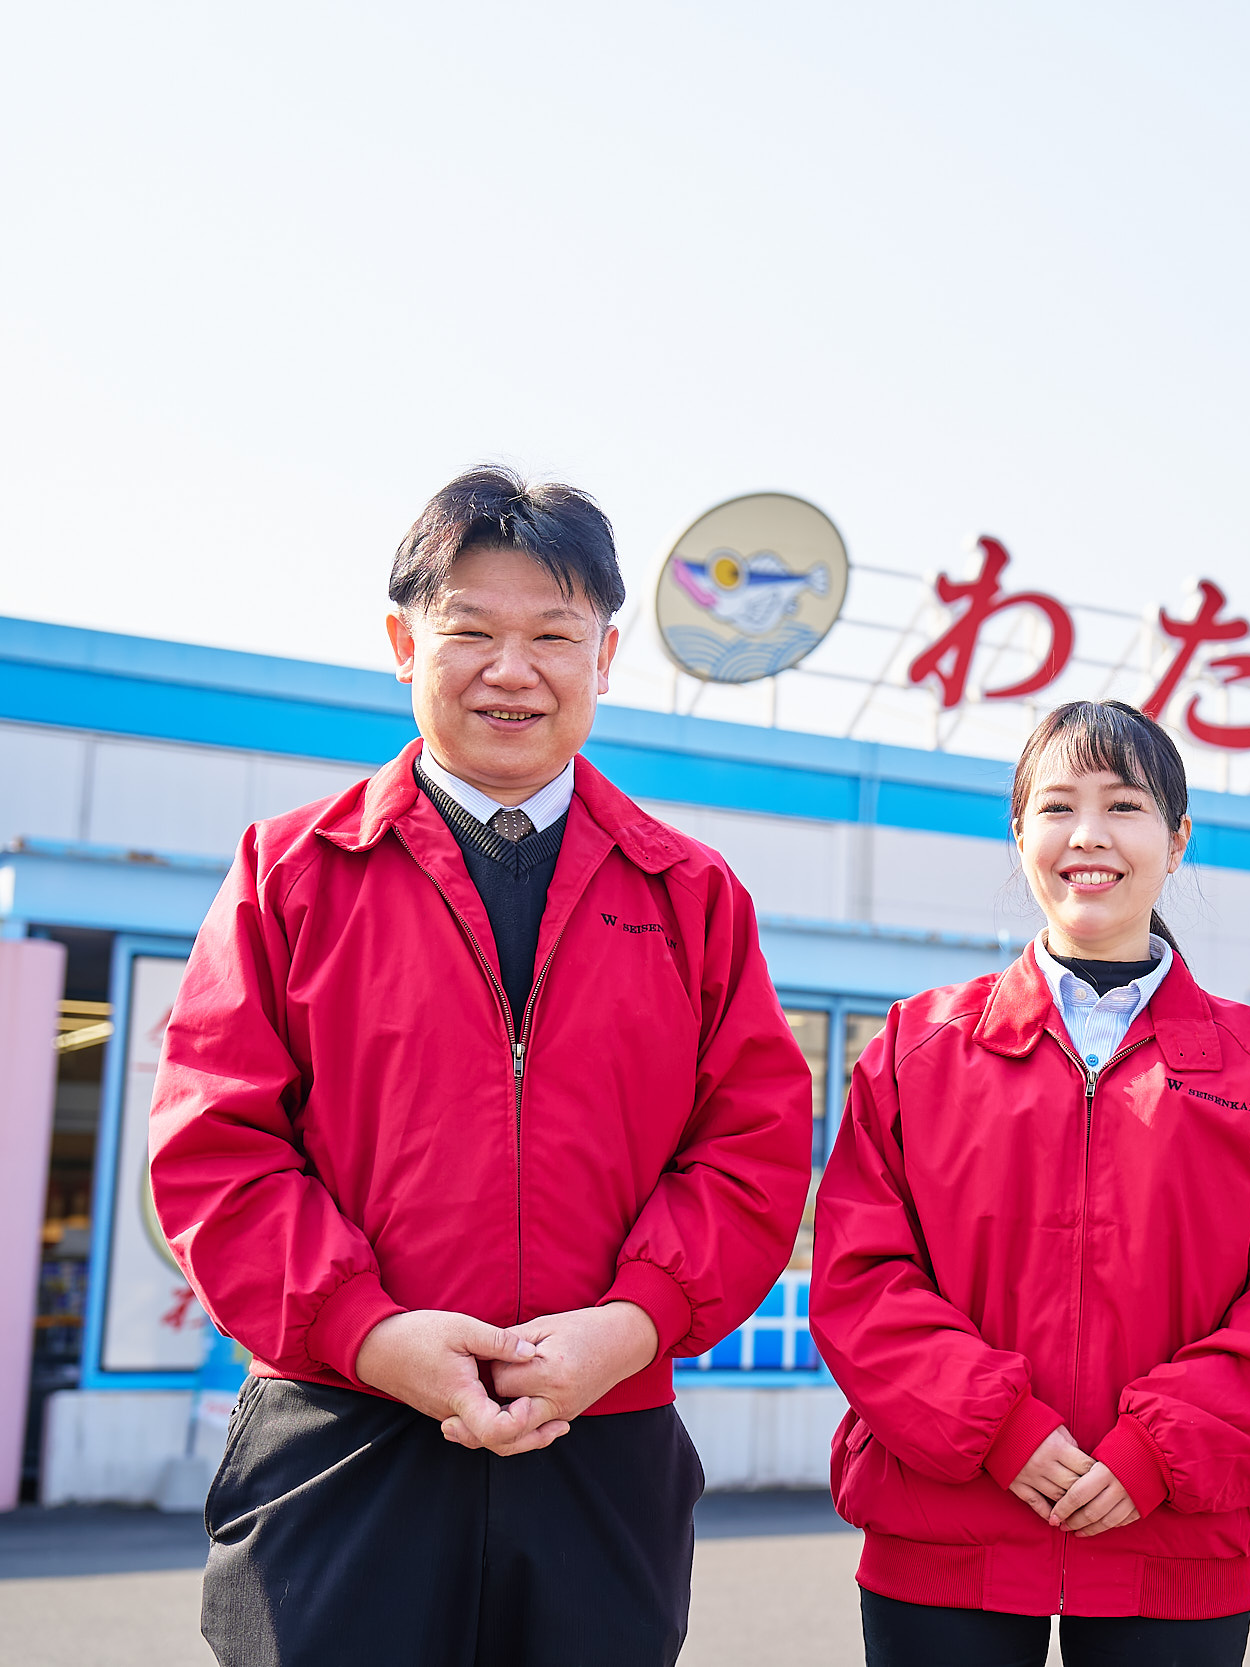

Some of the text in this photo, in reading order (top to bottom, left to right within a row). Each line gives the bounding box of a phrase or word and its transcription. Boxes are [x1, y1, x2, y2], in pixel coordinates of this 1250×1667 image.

[600, 912, 678, 951] W SEISENAN
[1165, 1077, 1184, 1092] W
